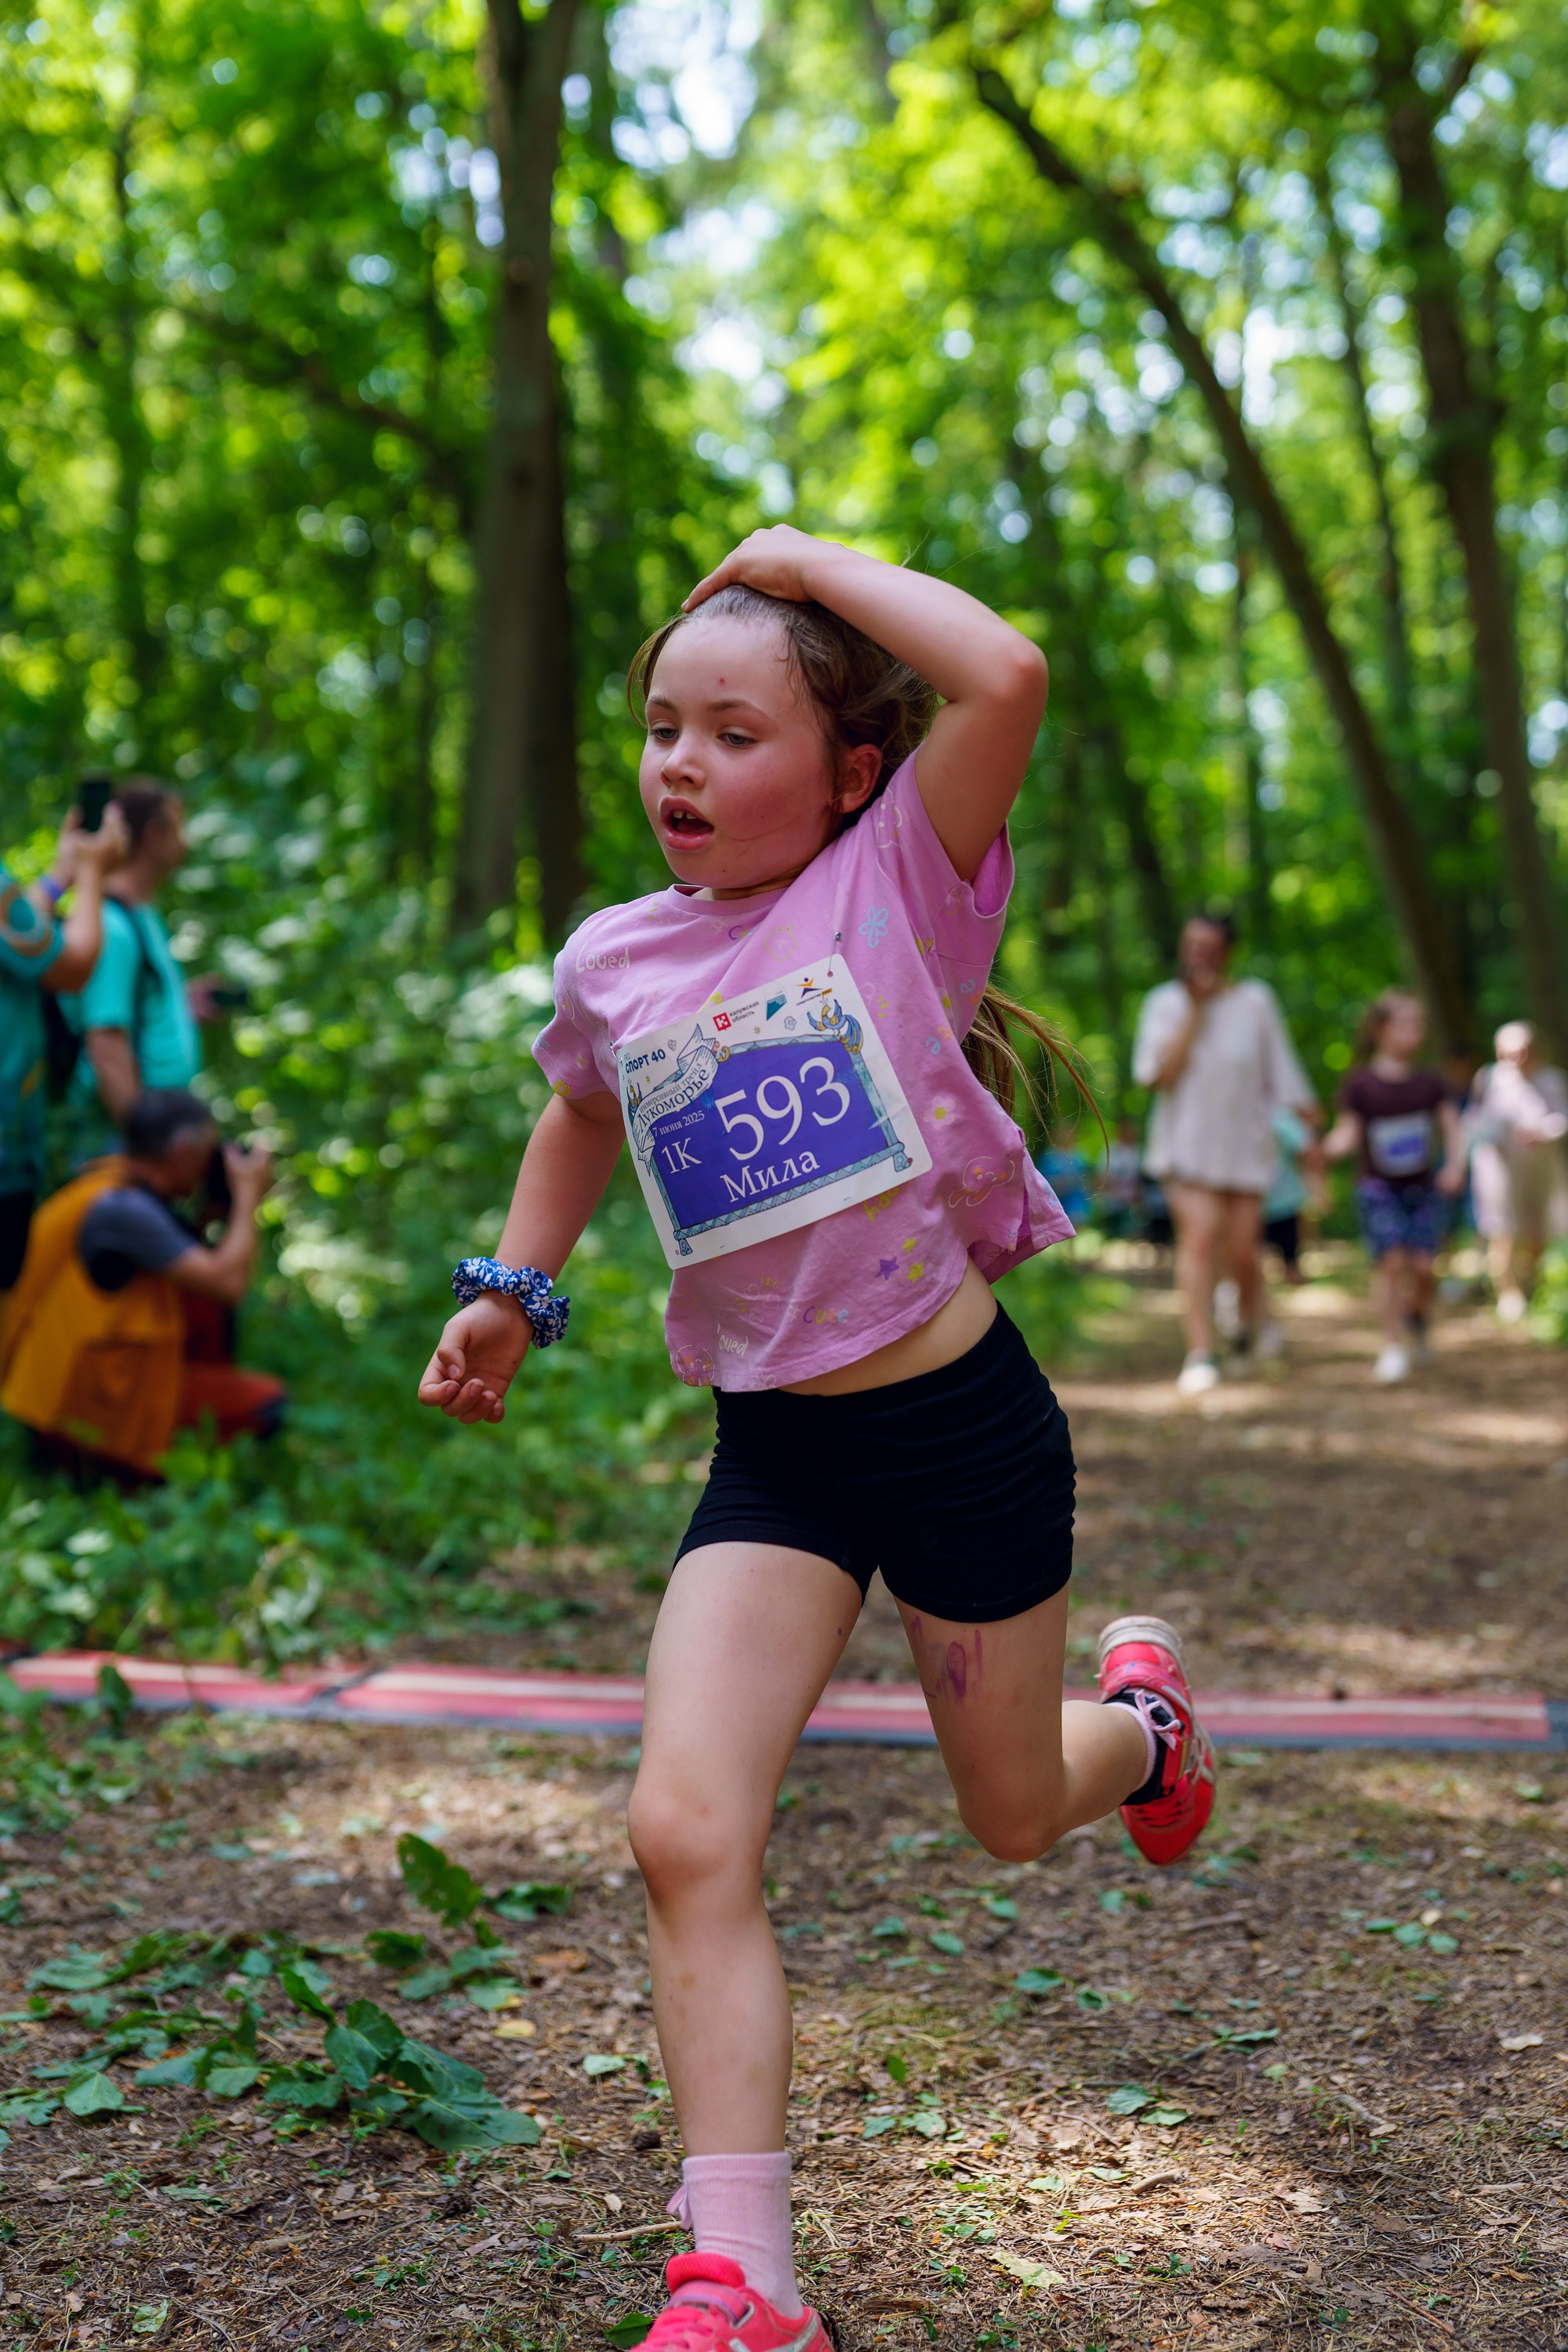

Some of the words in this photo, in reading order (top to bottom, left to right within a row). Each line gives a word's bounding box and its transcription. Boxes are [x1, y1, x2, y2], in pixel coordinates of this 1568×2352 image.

[625, 1054, 650, 1074] СПОРТ
[652, 1049, 666, 1062] 40
[637, 1069, 710, 1133] Лукоморье
[652, 1127, 658, 1138] 7
[659, 1123, 683, 1135] июня
[682, 1110, 705, 1127] 2025
[714, 1056, 851, 1160] 593
[720, 1150, 820, 1203] Мила
